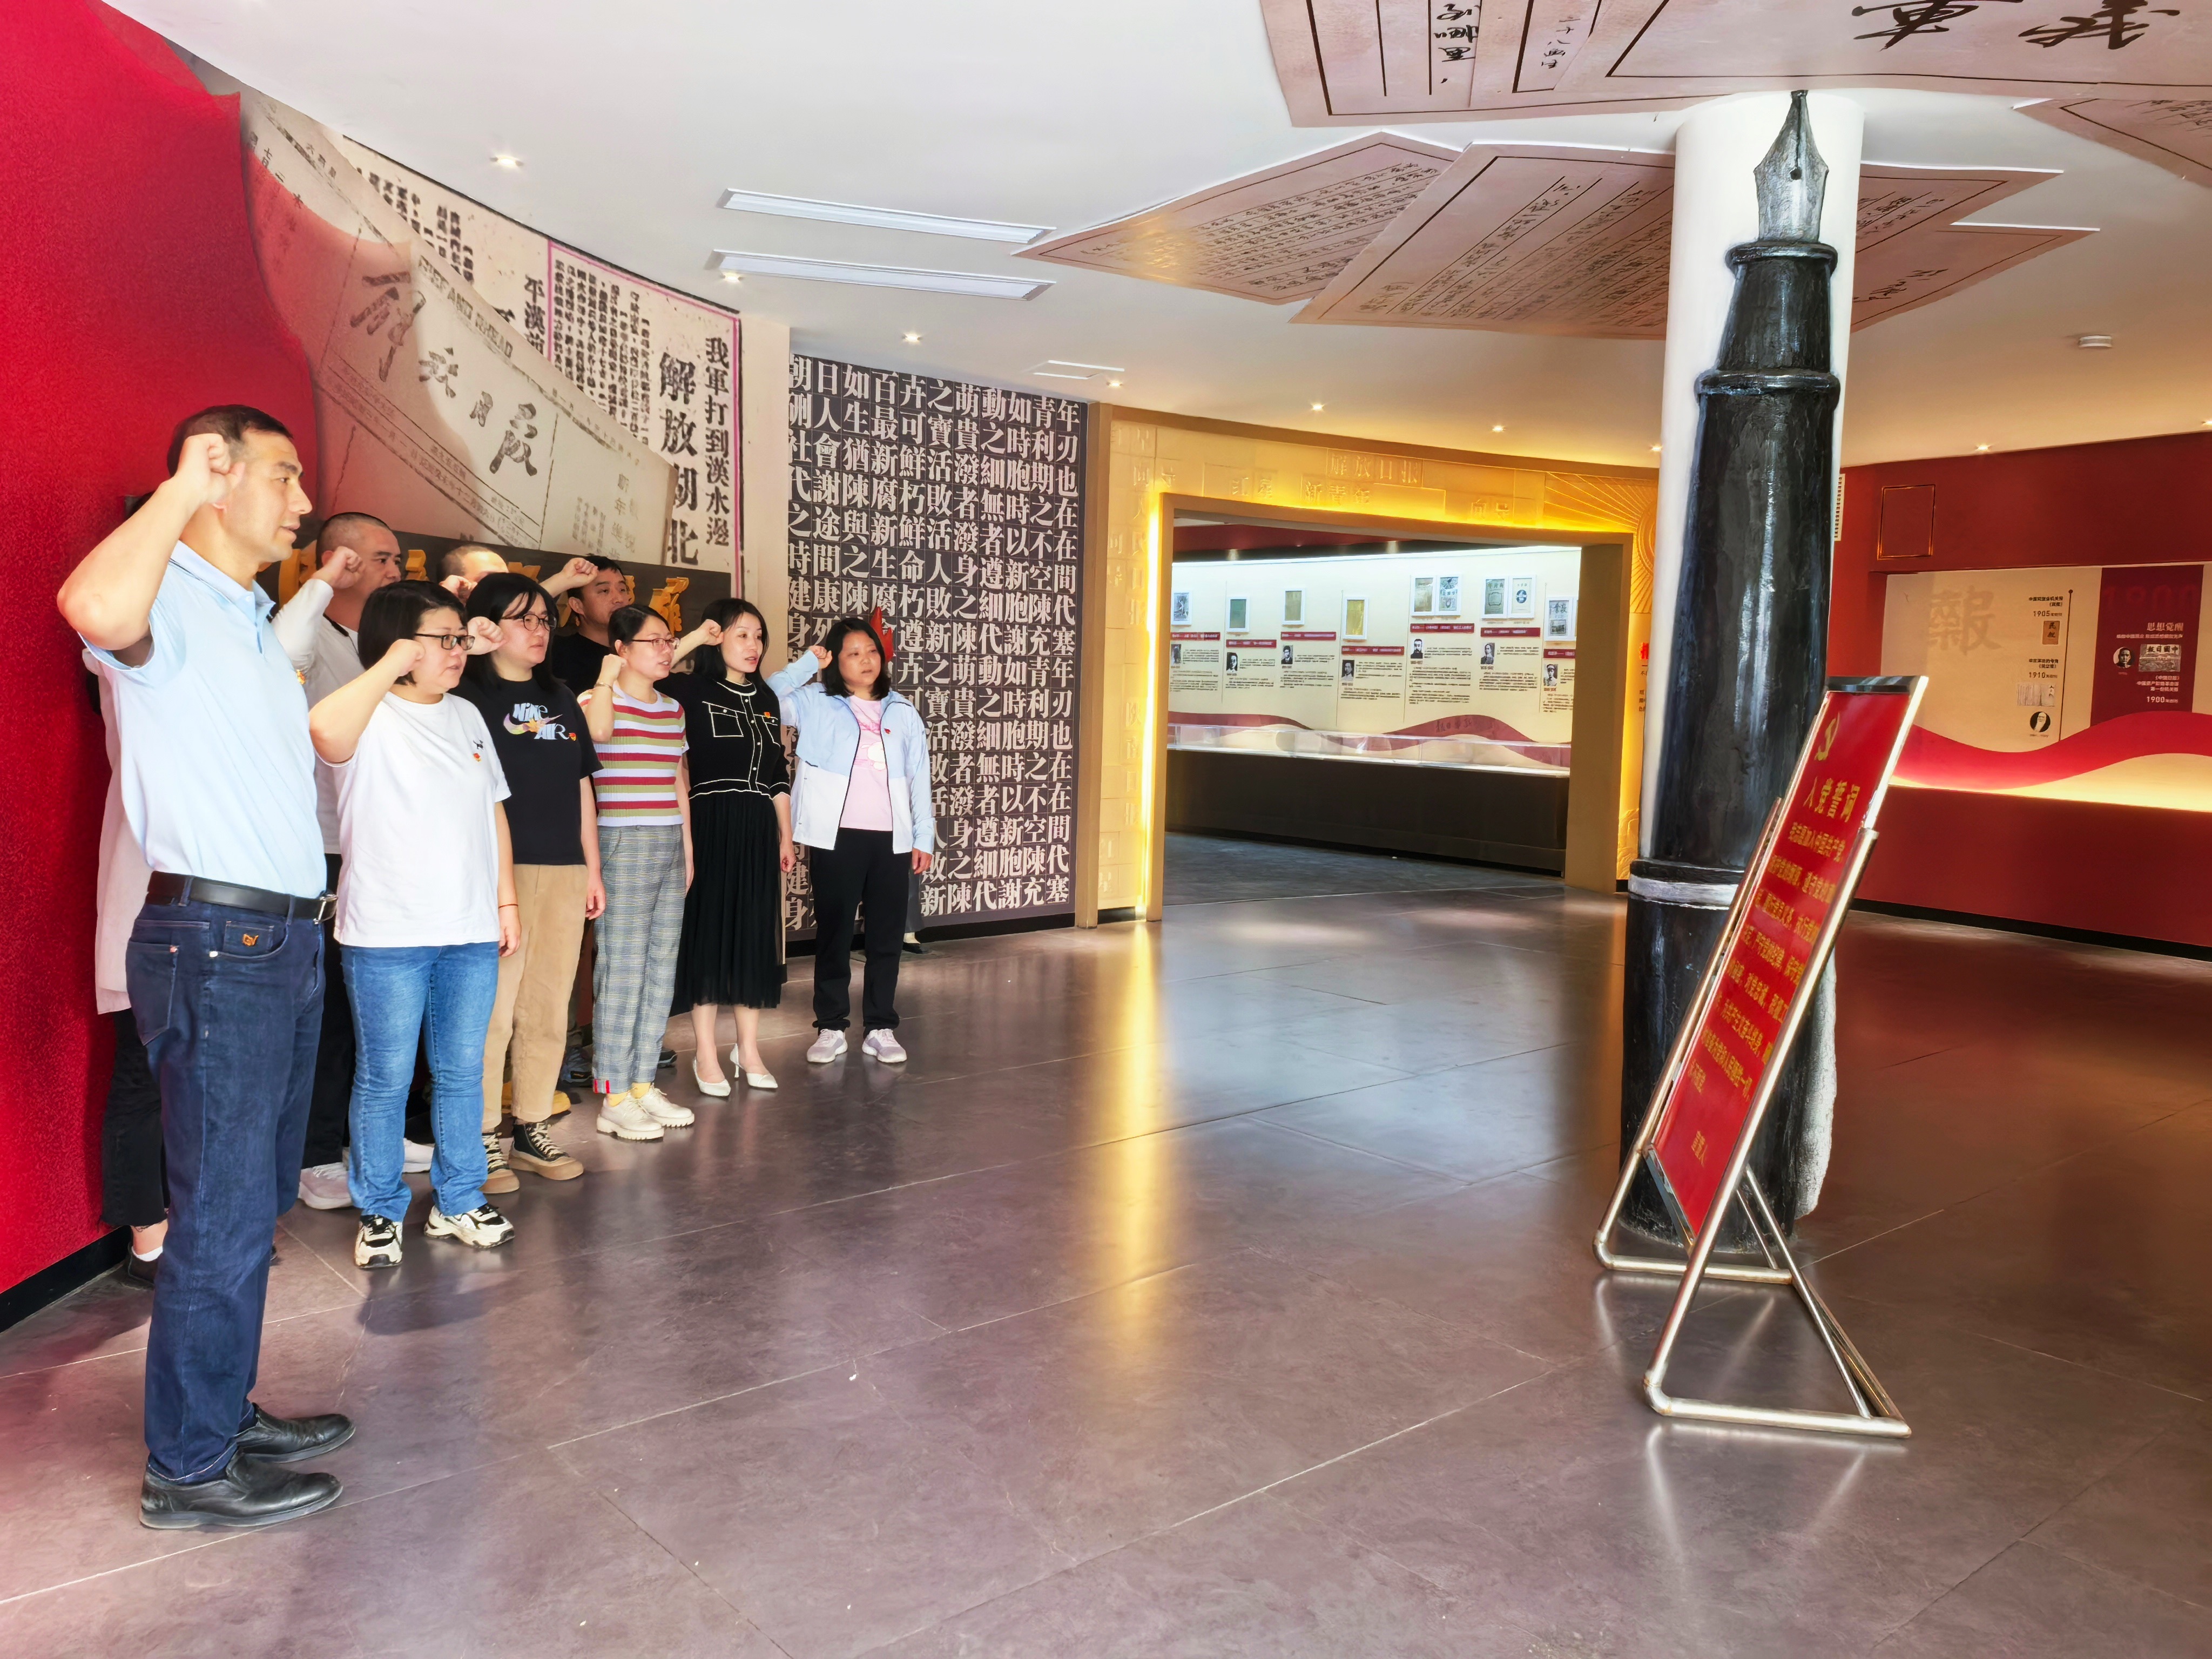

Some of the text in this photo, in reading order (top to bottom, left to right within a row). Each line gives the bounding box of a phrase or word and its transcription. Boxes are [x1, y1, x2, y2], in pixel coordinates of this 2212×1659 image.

[534, 723, 570, 740] AIR
[1803, 775, 1861, 822] 入党誓词
